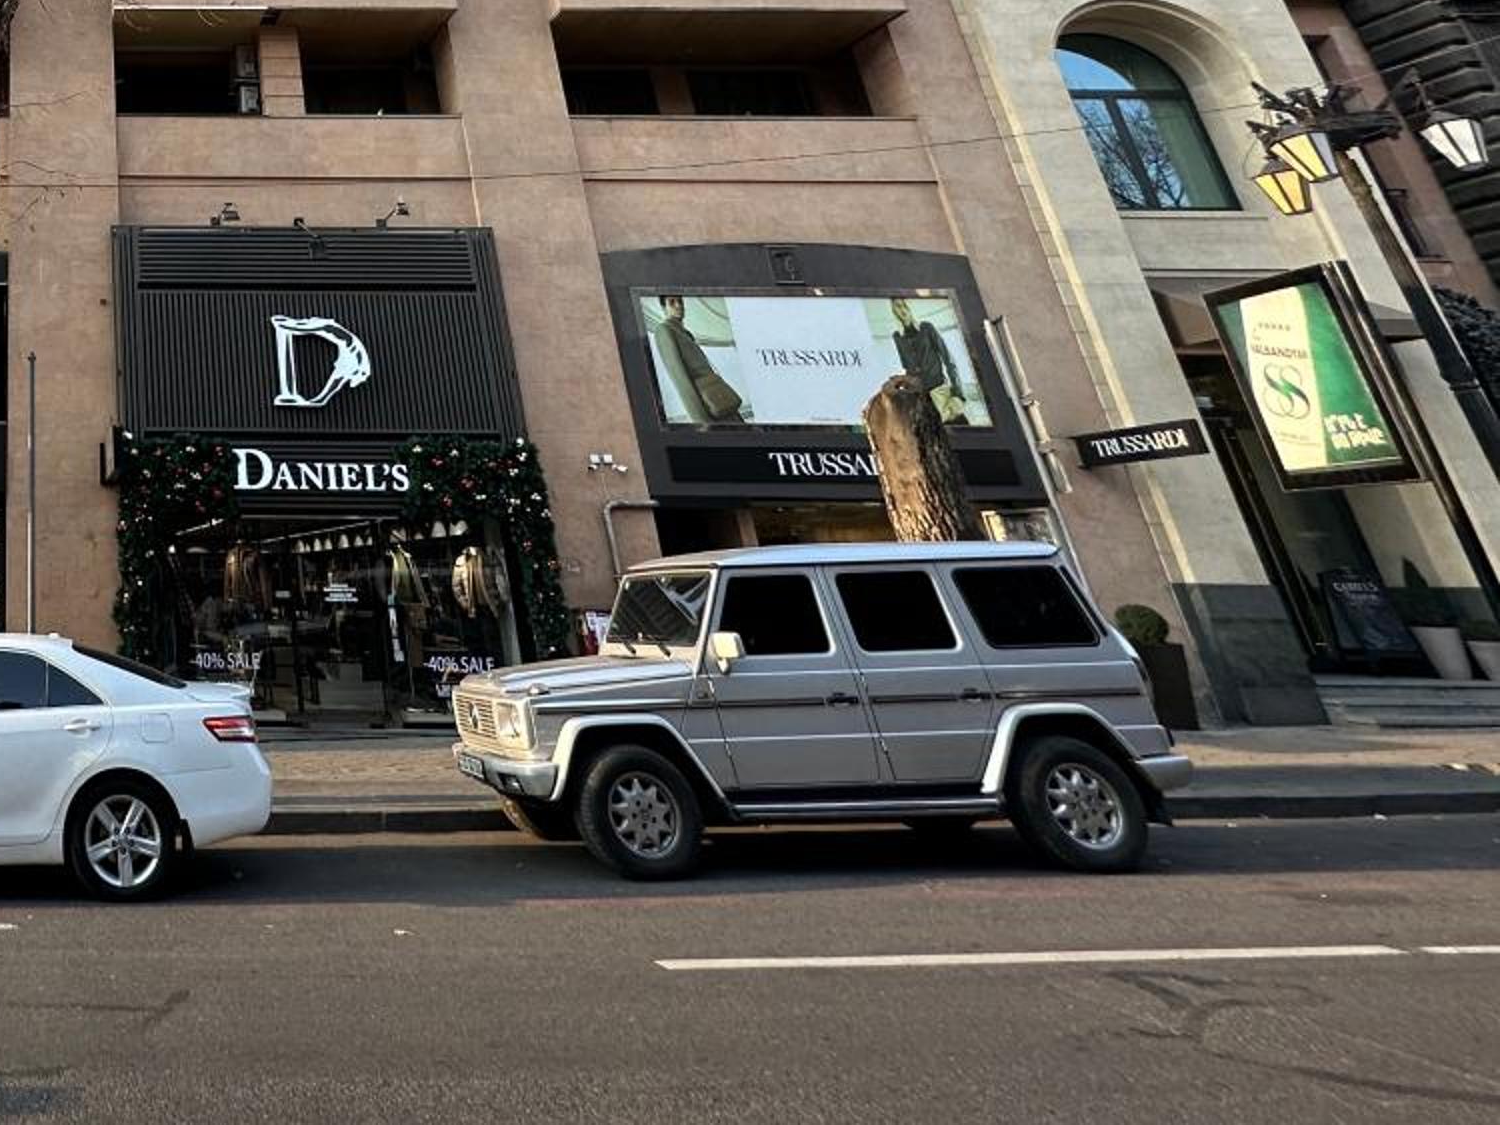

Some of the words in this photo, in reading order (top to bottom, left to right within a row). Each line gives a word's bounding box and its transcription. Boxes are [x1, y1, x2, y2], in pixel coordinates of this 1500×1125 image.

[756, 348, 862, 366] TRUSSARDI
[1092, 429, 1189, 457] TRUSSARDI
[227, 652, 260, 669] SALE
